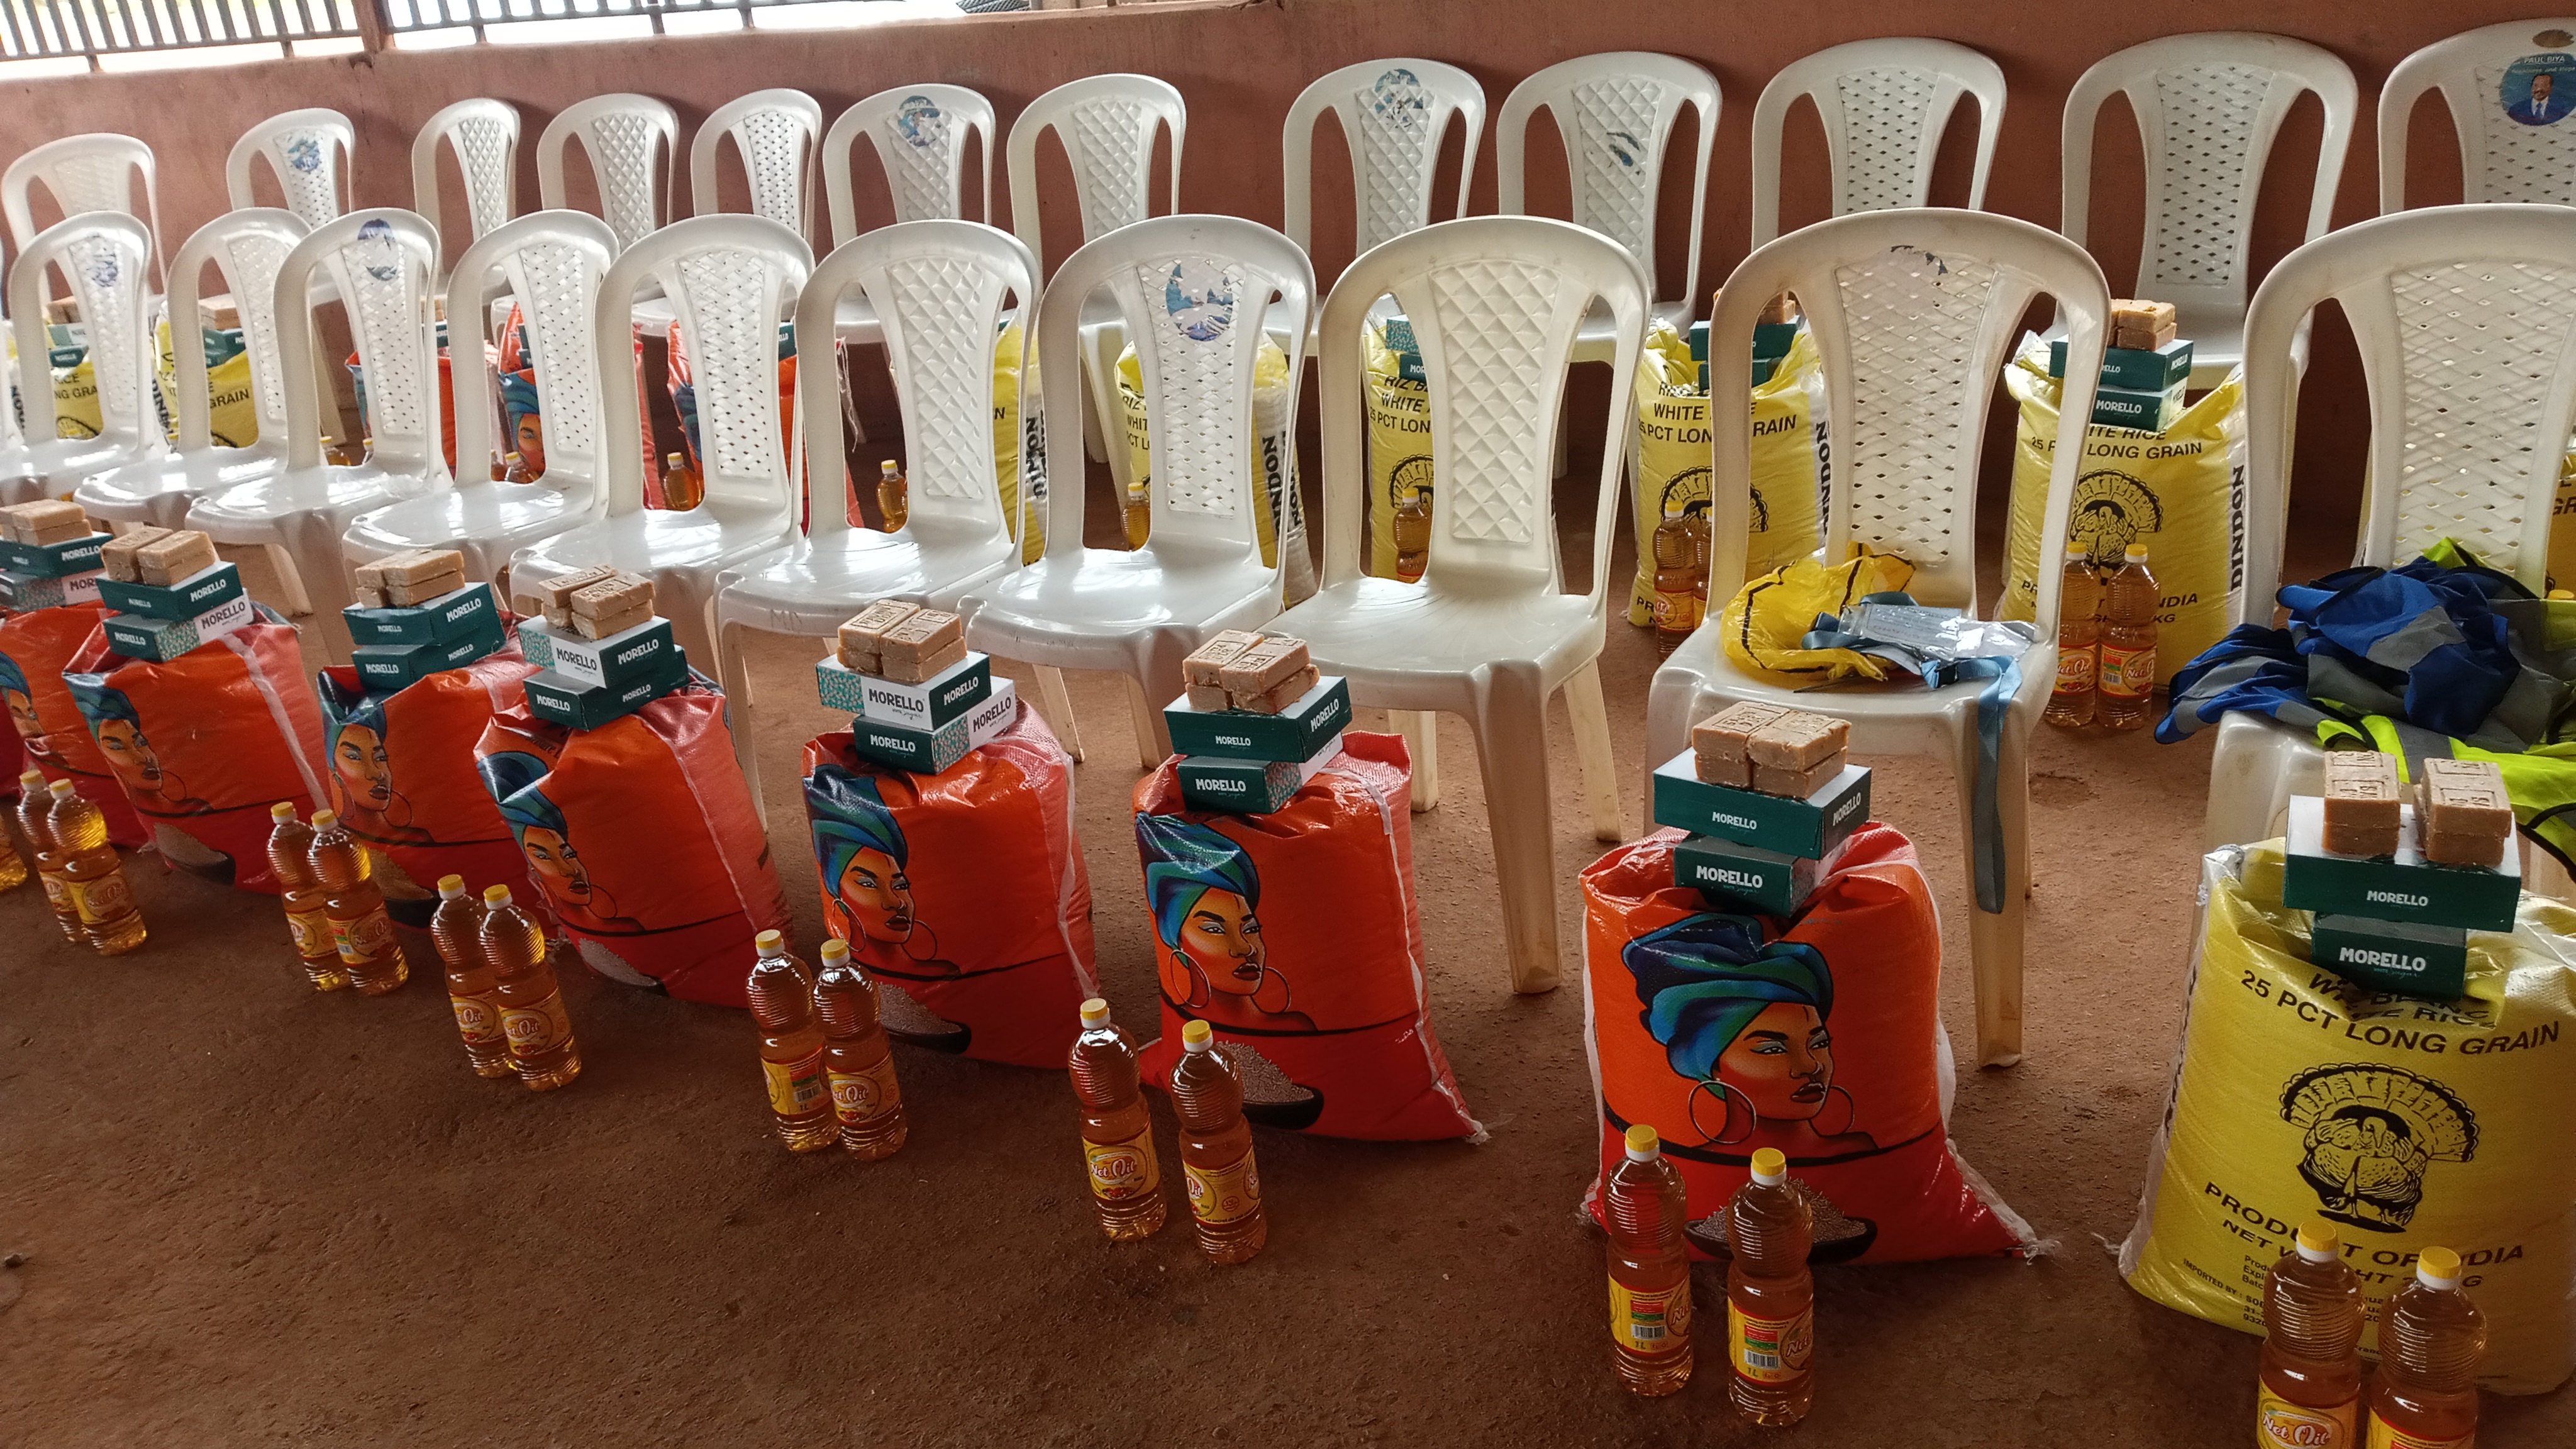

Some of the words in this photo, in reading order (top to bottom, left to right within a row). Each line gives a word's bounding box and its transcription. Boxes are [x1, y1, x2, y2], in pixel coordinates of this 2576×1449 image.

[2101, 364, 2121, 374] ELLO
[72, 385, 97, 398] GRA
[209, 388, 250, 409] GRAIN
[1379, 392, 1425, 413] WHITE
[1653, 402, 1704, 421] WHITE
[2096, 399, 2142, 415] MORELLO
[1127, 415, 1148, 431] WHIT
[1377, 413, 1397, 430] PCT
[1401, 418, 1431, 434] LON
[1647, 424, 1674, 441] PCT
[1677, 427, 1712, 444] LON
[1753, 414, 1797, 437] RAIN
[2088, 425, 2118, 438] ITE
[2087, 443, 2140, 459] LONG
[2146, 442, 2202, 460] GRAIN
[2231, 464, 2245, 592] DINDON
[62, 545, 101, 562] MORELLO
[190, 578, 226, 602] MORELLO
[2158, 592, 2199, 608] NDIA
[201, 601, 246, 630] MORELLO
[446, 597, 482, 623] MORELLO
[114, 631, 146, 647] MORELLO
[448, 643, 474, 662] MORELLO
[557, 647, 597, 671] MORELLO
[617, 638, 660, 665] MORELLO
[365, 663, 399, 675] MORELLO
[622, 684, 652, 702] MORELLO
[869, 688, 924, 713] MORELLO
[943, 676, 979, 706] MORELLO
[536, 694, 571, 713] MORELLO
[973, 696, 1011, 733] MORELLO
[1310, 698, 1340, 733] MORELLO
[870, 734, 916, 753] MORELLO
[1215, 735, 1252, 747] MORELLO
[1196, 779, 1246, 792] MORELLO
[1833, 792, 1862, 827] MORELLO
[1712, 811, 1757, 830] MORELLO
[1696, 865, 1763, 889] MORELLO
[2367, 890, 2429, 907] MORELLO
[2339, 947, 2427, 972] MORELLO
[2241, 969, 2270, 998] 25
[2277, 991, 2344, 1030] PCT
[2345, 1021, 2447, 1055] LONG
[2460, 1020, 2560, 1056] GRAIN
[845, 1085, 869, 1102] Oil
[1090, 1162, 1108, 1178] Net
[1111, 1158, 1135, 1177] Oil
[2204, 1181, 2364, 1258] PRODT
[2459, 1244, 2524, 1268] NDIA
[2223, 1218, 2272, 1249] NET
[2183, 1258, 2224, 1289] IMPORTED
[2225, 1283, 2237, 1295] BY
[2242, 1275, 2264, 1290] Batc
[2263, 1412, 2290, 1440] Net
[2294, 1424, 2331, 1446] Oil
